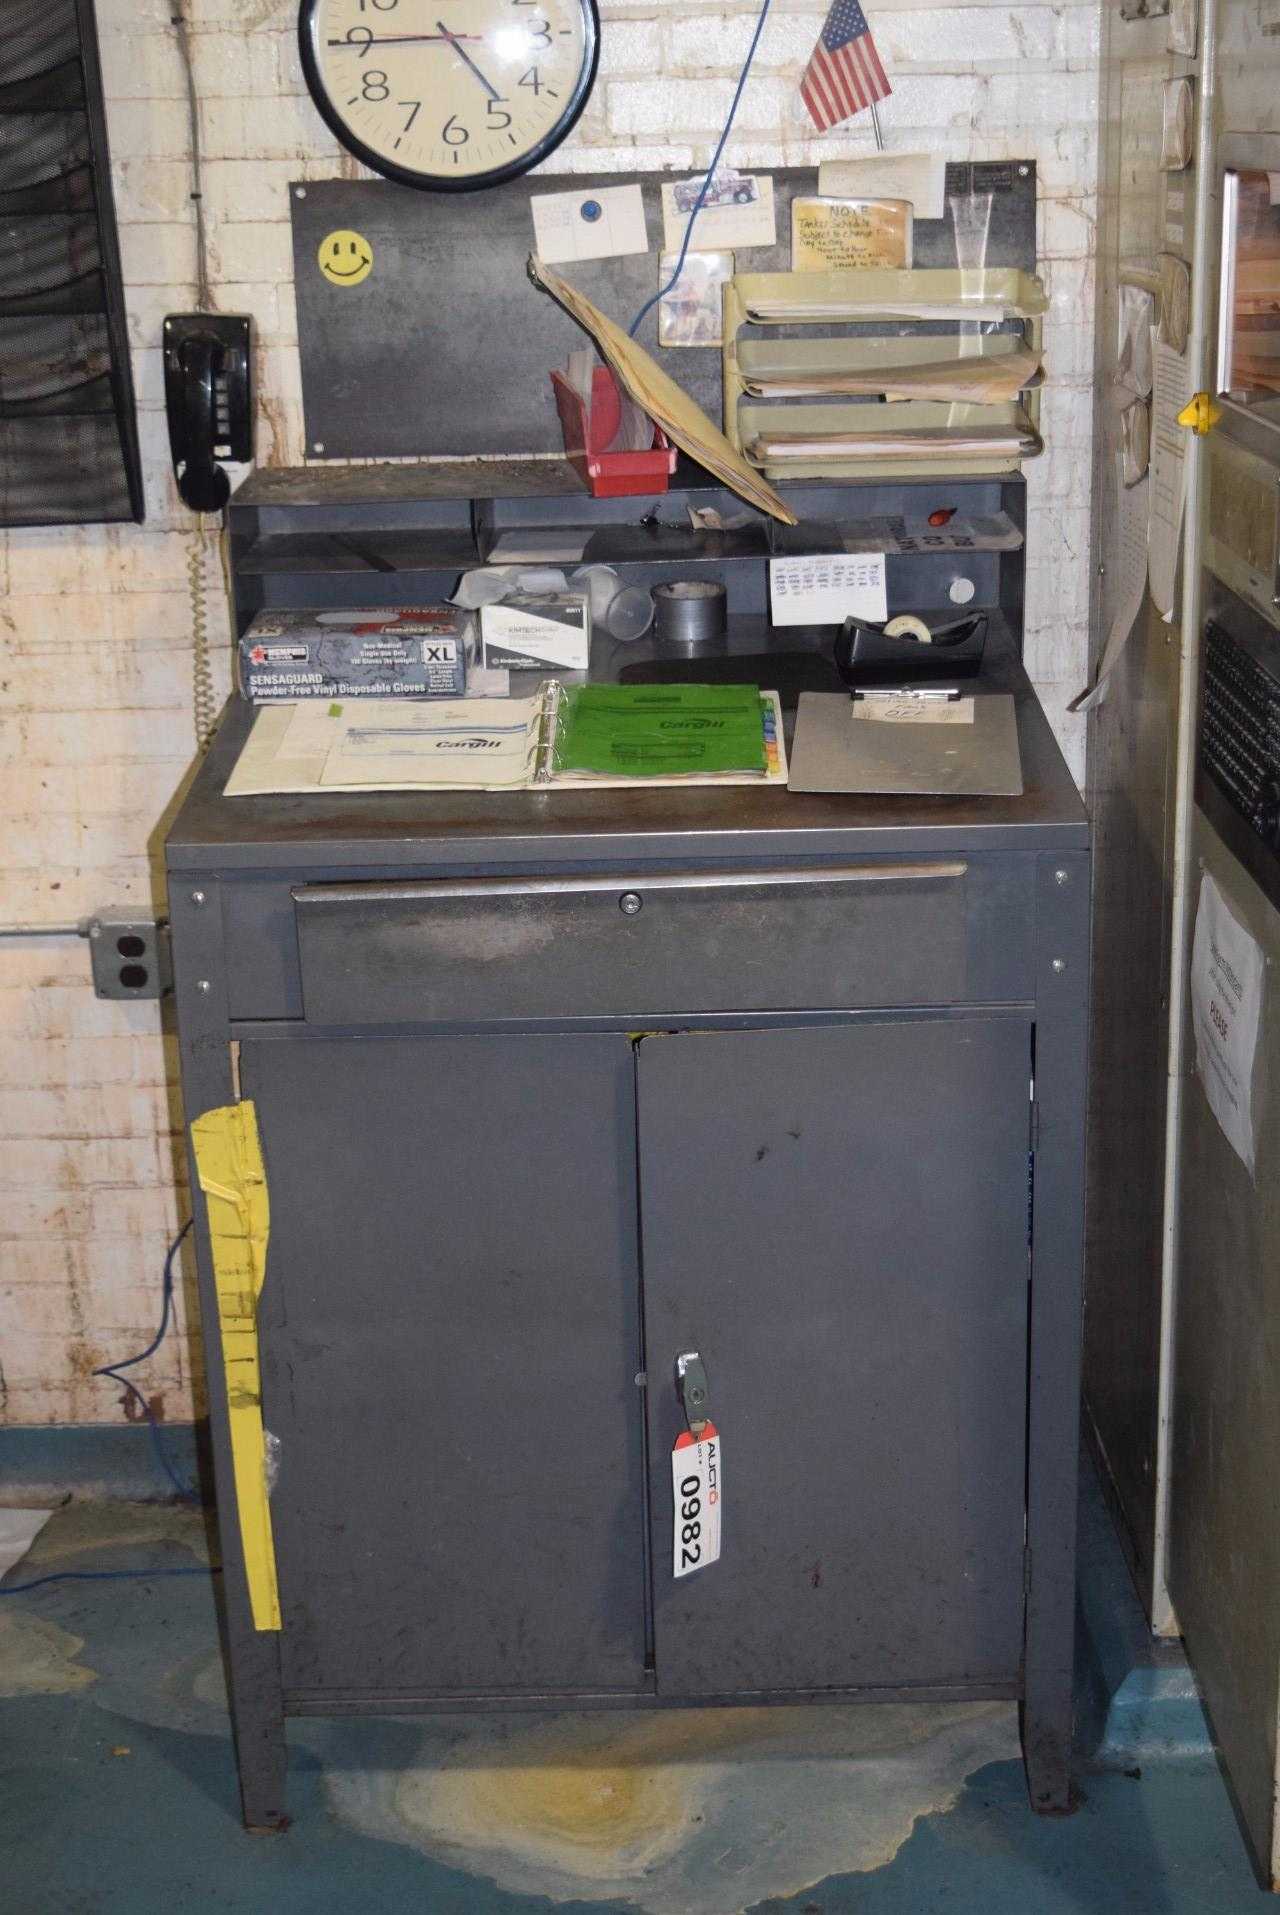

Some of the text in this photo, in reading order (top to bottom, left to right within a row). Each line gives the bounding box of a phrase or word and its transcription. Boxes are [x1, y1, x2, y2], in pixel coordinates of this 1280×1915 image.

[346, 26, 374, 58] 9
[527, 19, 553, 51] 3
[362, 70, 391, 101] 8
[517, 66, 545, 96] 4
[398, 102, 421, 132] 7
[486, 98, 512, 130] 5
[442, 115, 470, 145] 6
[426, 647, 455, 661] XL
[249, 673, 323, 686] SENSAGUARD
[250, 682, 427, 697] Powder-Free Vinyl Disposable Gloves
[660, 718, 725, 730] Cargill
[435, 738, 502, 749] Cargill
[680, 1475, 701, 1569] 0982
